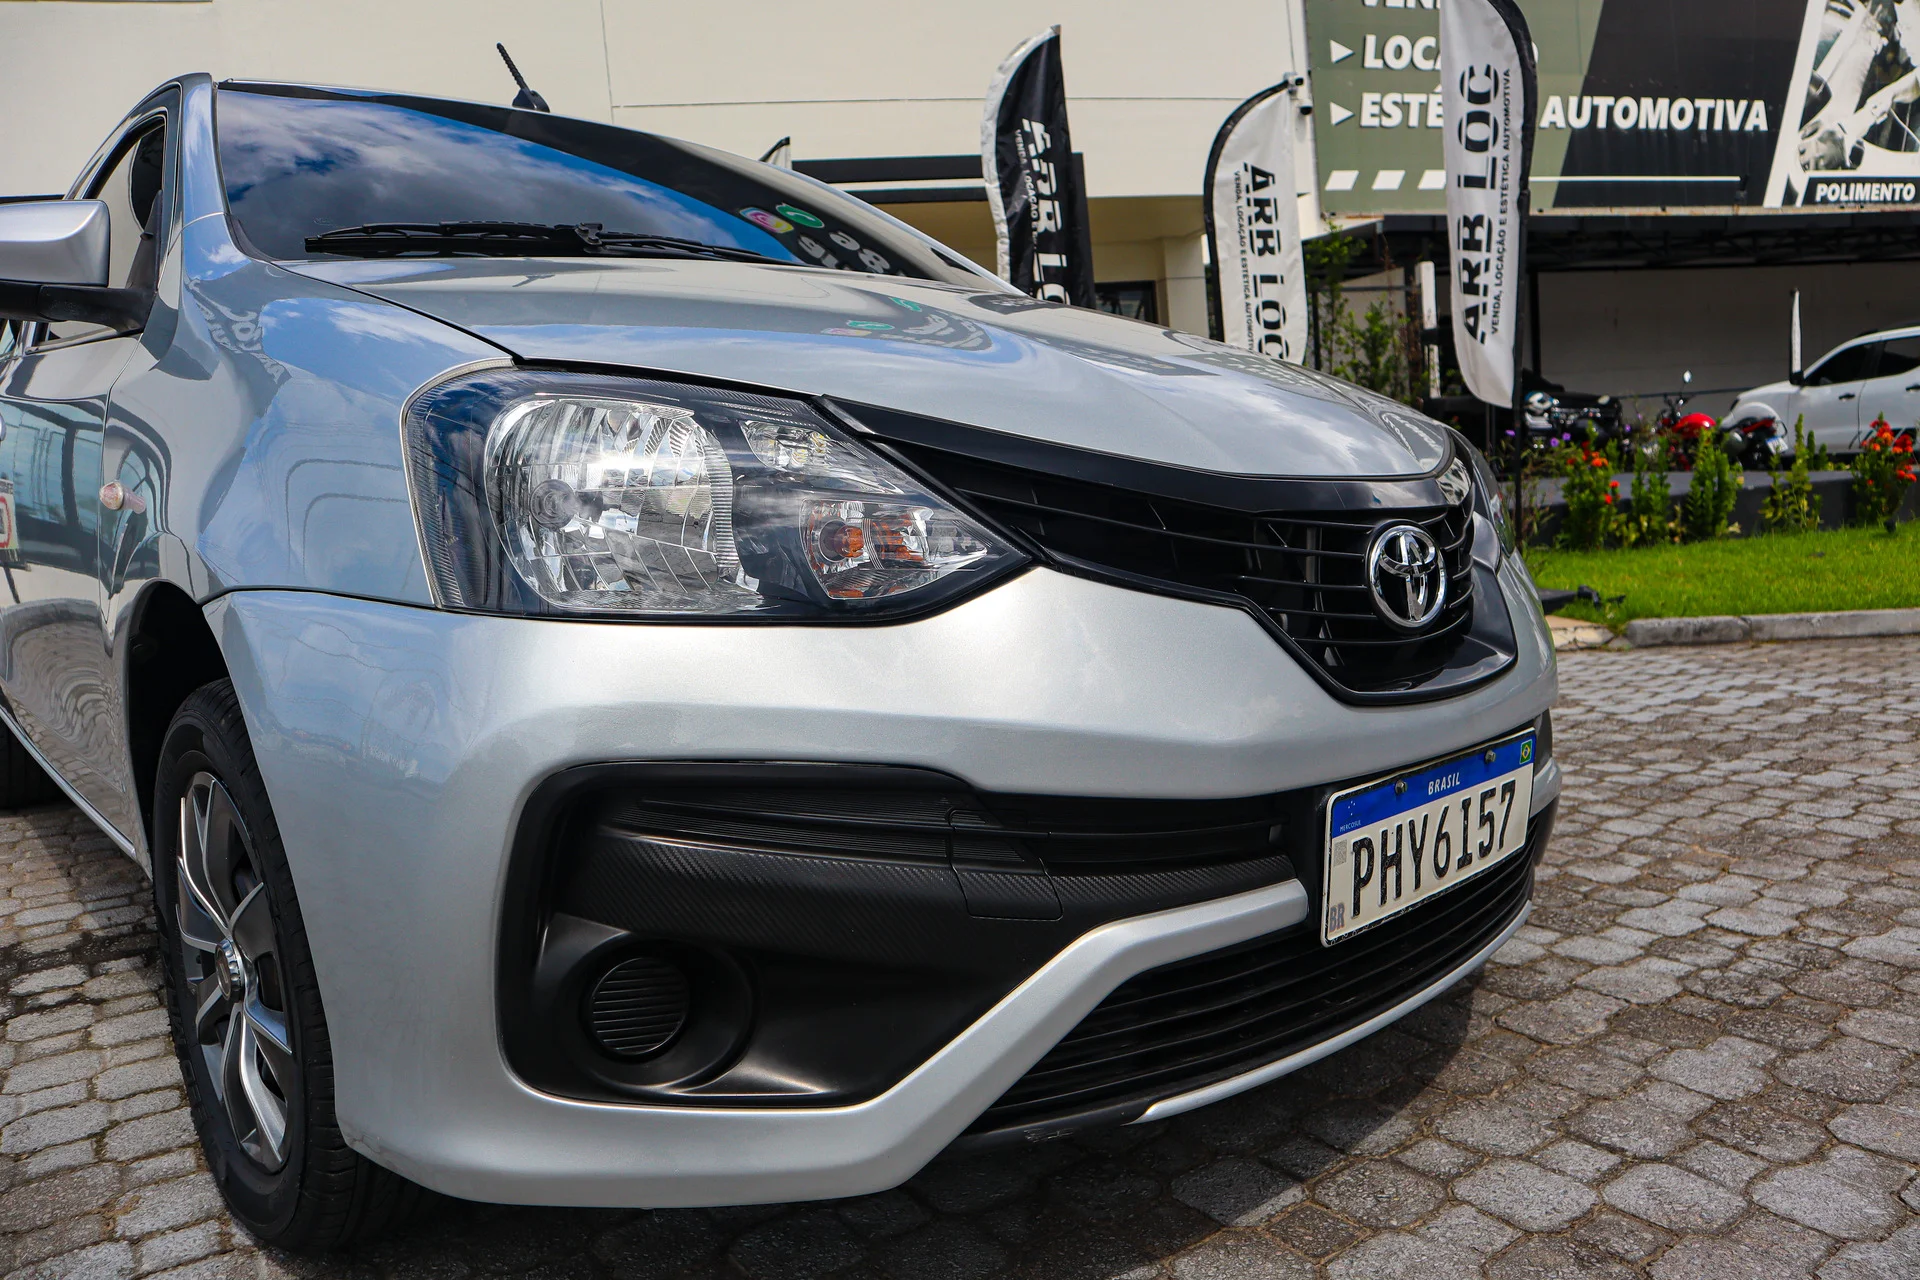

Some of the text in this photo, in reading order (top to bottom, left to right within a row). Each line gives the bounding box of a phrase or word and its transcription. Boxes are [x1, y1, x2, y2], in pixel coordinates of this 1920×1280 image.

[1502, 68, 1510, 151] AUTOMOTIVA
[1538, 95, 1769, 132] AUTOMOTIVA
[1243, 161, 1282, 257] ARB
[1457, 63, 1499, 345] ARB LOC
[1814, 182, 1917, 203] POLIMENTO
[1499, 217, 1507, 226] E
[1495, 229, 1507, 287] LOCAÇÃO
[1427, 771, 1461, 797] BRASIL
[1350, 778, 1516, 920] PHY6I57
[1329, 902, 1345, 933] BR
